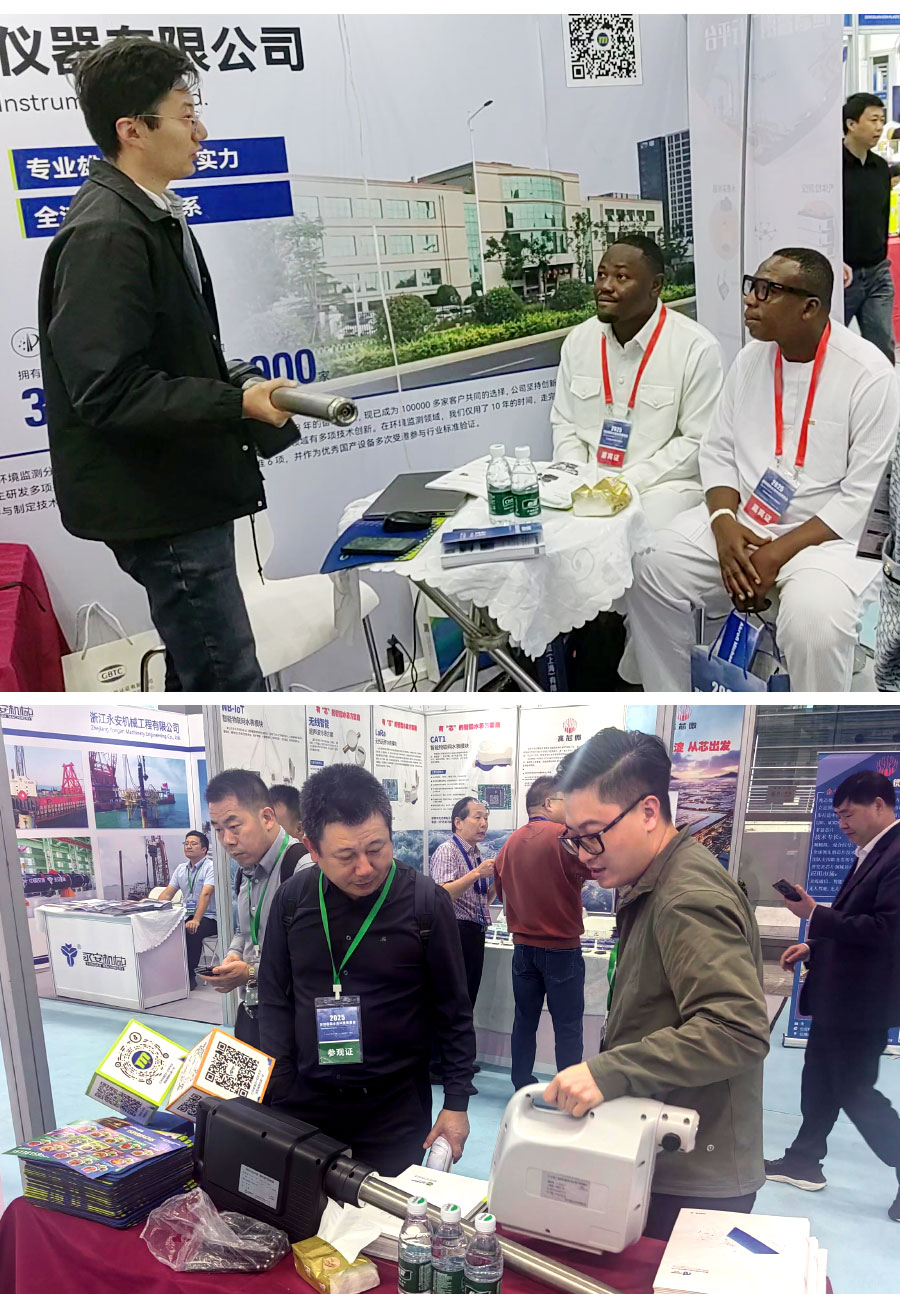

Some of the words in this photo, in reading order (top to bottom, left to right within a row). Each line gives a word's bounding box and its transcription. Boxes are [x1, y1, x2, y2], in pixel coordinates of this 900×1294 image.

[0, 25, 304, 76] 仪器限公司
[101, 668, 123, 680] GBTC
[90, 711, 180, 734] 浙江永安机械工程有限公司
[430, 735, 447, 744] CAT1
[329, 1014, 346, 1022] 2025
[327, 1047, 354, 1057] 参观证
